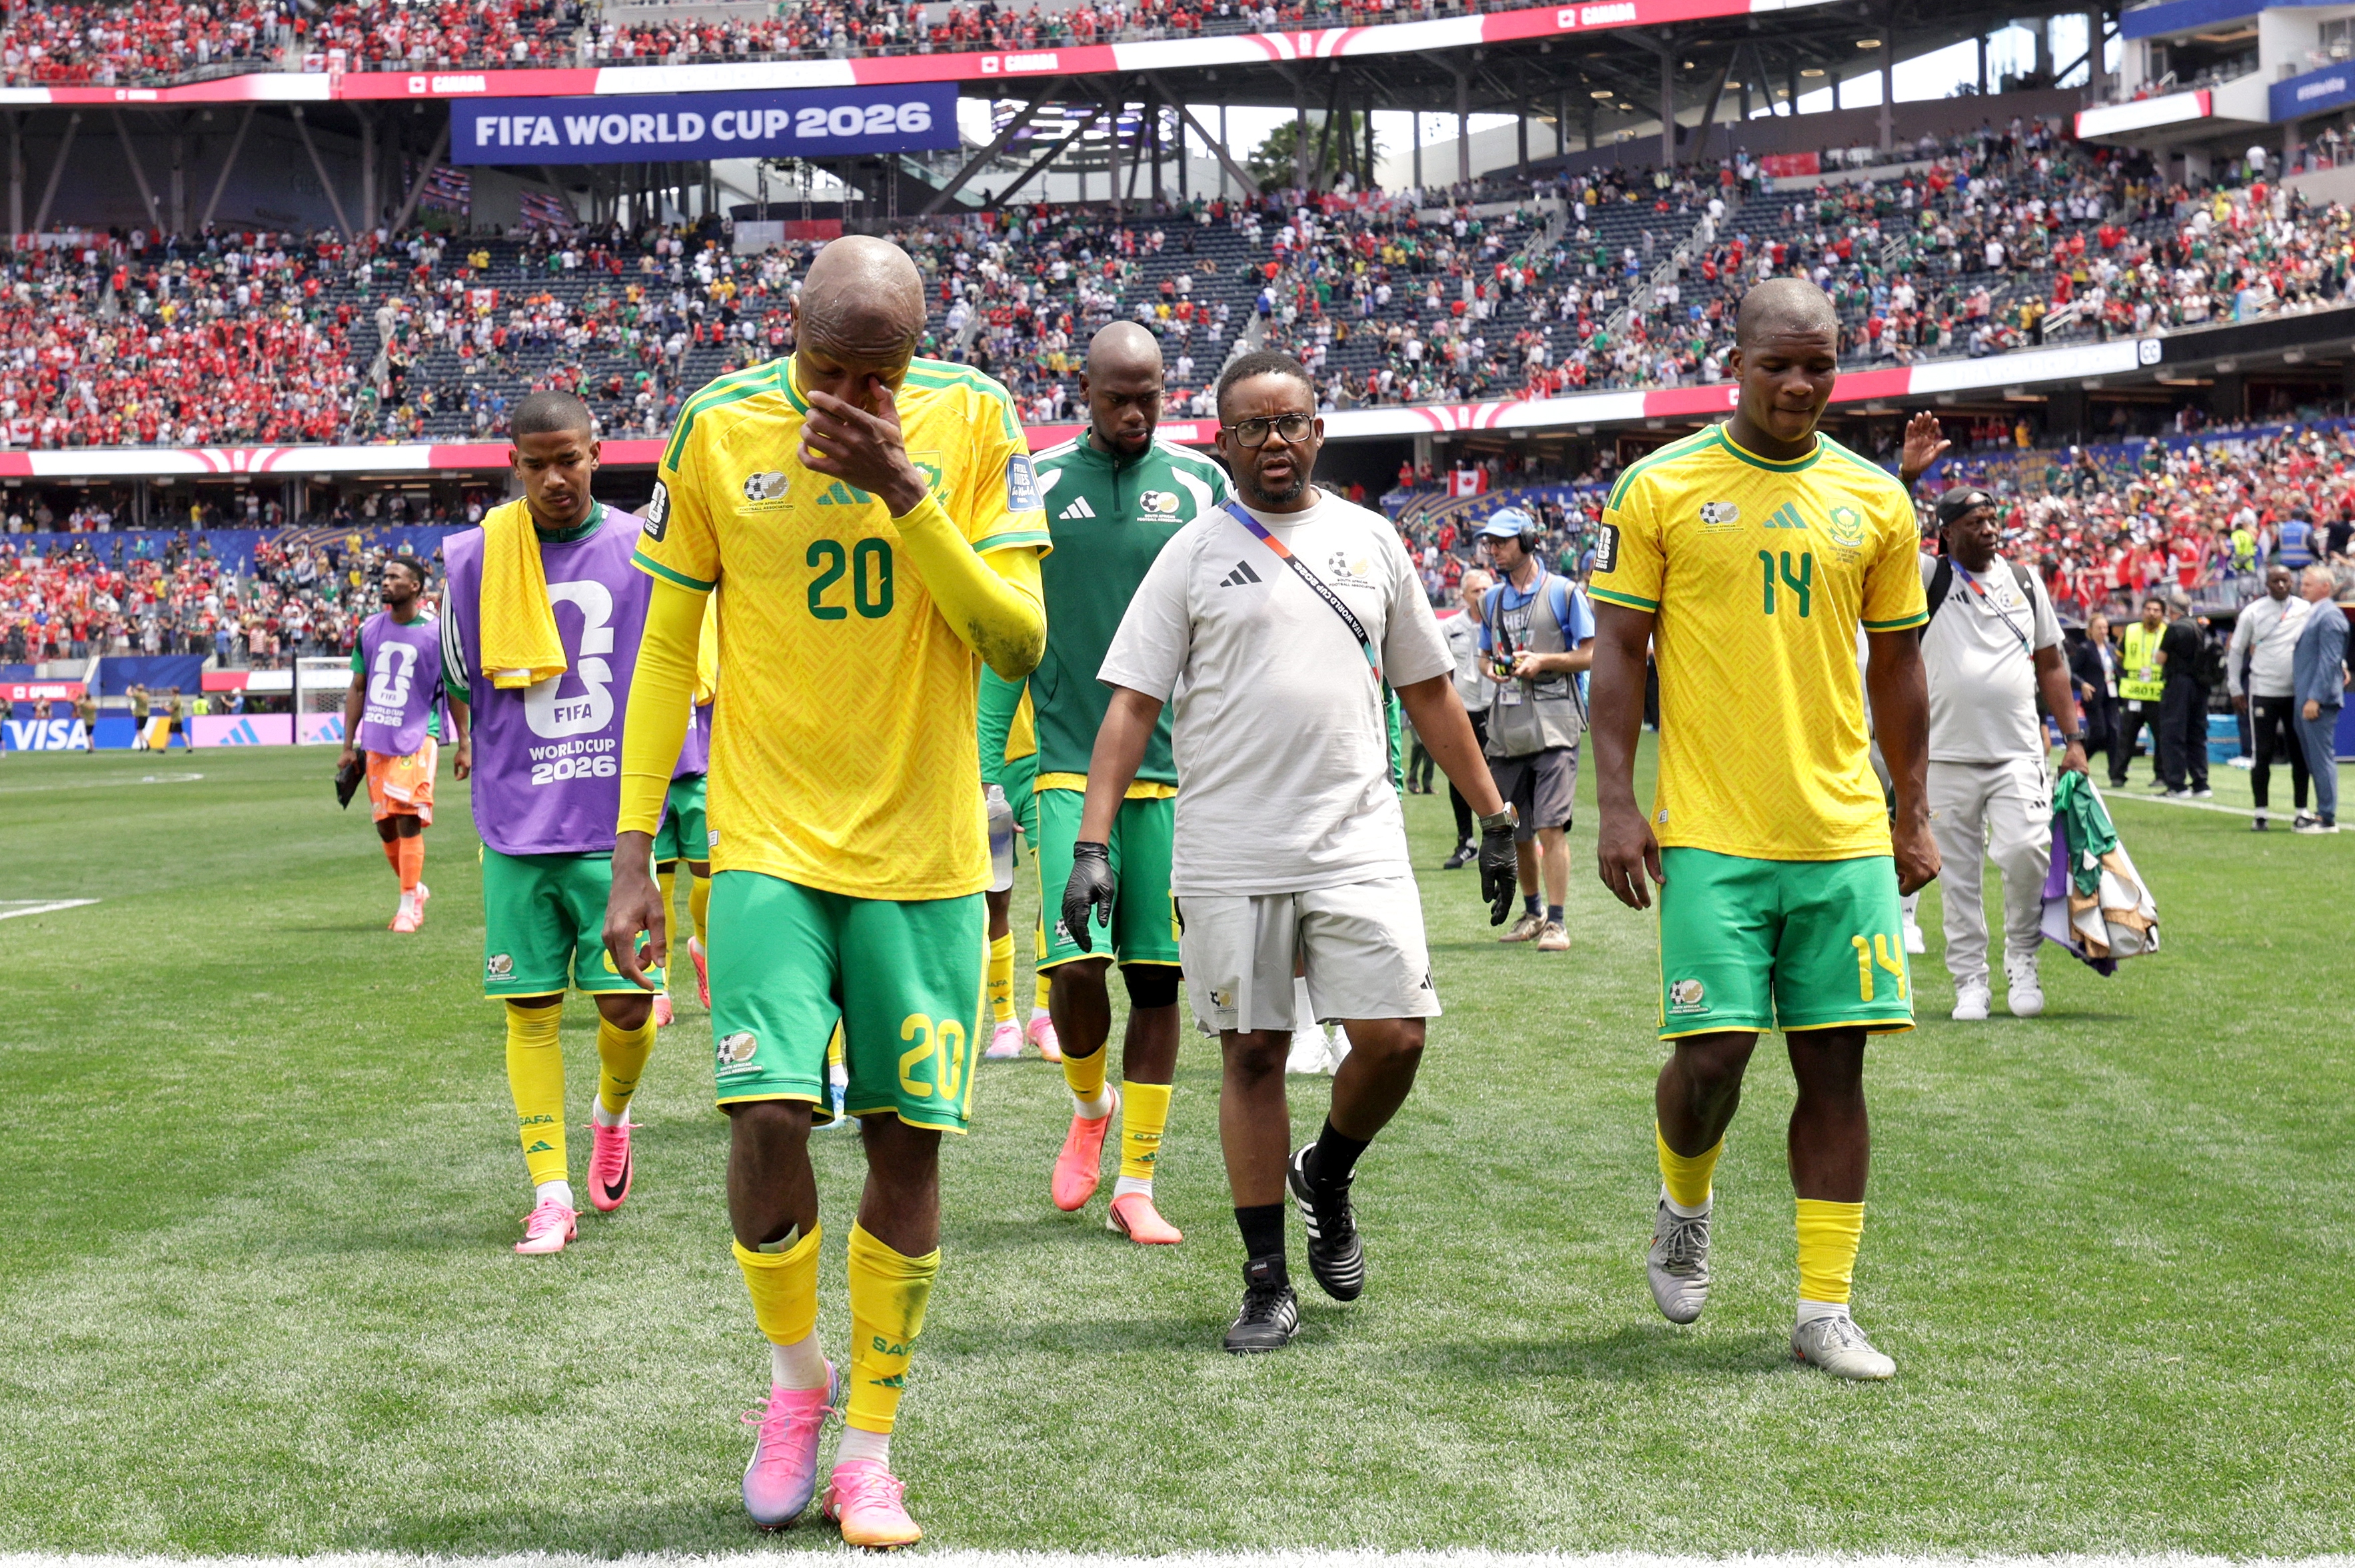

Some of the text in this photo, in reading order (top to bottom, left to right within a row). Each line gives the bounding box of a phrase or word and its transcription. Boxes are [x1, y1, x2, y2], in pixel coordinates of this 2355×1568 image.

[1581, 2, 1636, 25] CANADA
[1004, 53, 1058, 72] CANADA
[432, 75, 486, 93] CANADA
[476, 101, 932, 146] FIFA WORLD CUP 2026
[806, 537, 894, 620] 20
[1759, 550, 1812, 618] 14
[1293, 560, 1365, 638] FIFA WORLD CUP 2026
[29, 685, 66, 698] CANADA
[381, 692, 397, 702] FIFA
[364, 712, 402, 727] 2026
[554, 703, 592, 723] FIFA
[3, 718, 90, 750] VISA
[529, 738, 616, 760] WORLD CUP
[531, 755, 617, 785] 2026
[1851, 934, 1906, 1002] 14
[899, 1012, 965, 1101] 20
[732, 1066, 762, 1074] ASSOCIATION
[519, 1114, 554, 1126] SAFA
[1251, 1261, 1267, 1271] adidas
